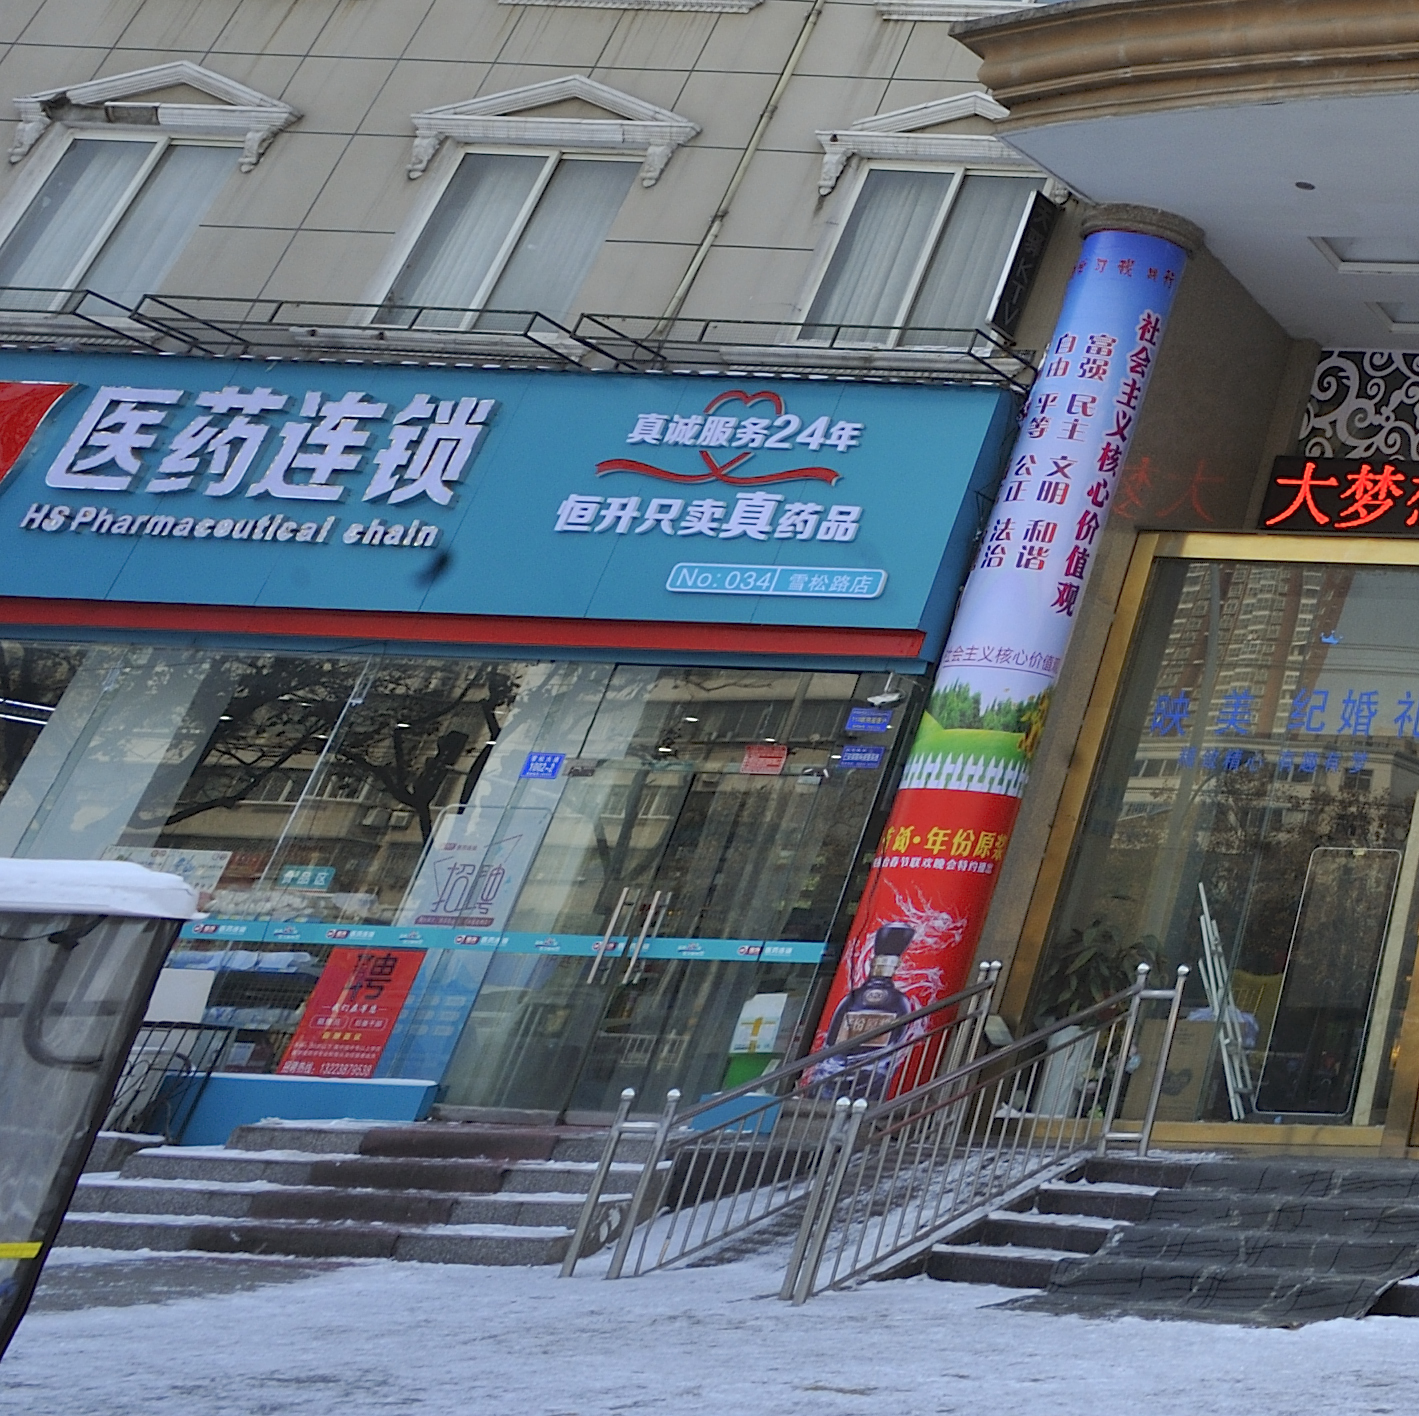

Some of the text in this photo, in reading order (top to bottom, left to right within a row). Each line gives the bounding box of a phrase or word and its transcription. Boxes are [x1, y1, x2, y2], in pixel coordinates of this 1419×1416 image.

[46, 384, 497, 507] 医药连锁
[626, 413, 865, 452] 真诚服务24年
[980, 333, 1077, 569] 自由 平等 公正 法治
[1014, 333, 1118, 572] 富强 民主 文明 和谐
[1050, 308, 1162, 616] 社会主义核心价值观
[70, 505, 338, 546] Pharmaceutical
[342, 517, 443, 549] chain
[553, 491, 864, 543] 恒升只卖真药品
[787, 572, 875, 595] 雪松路店
